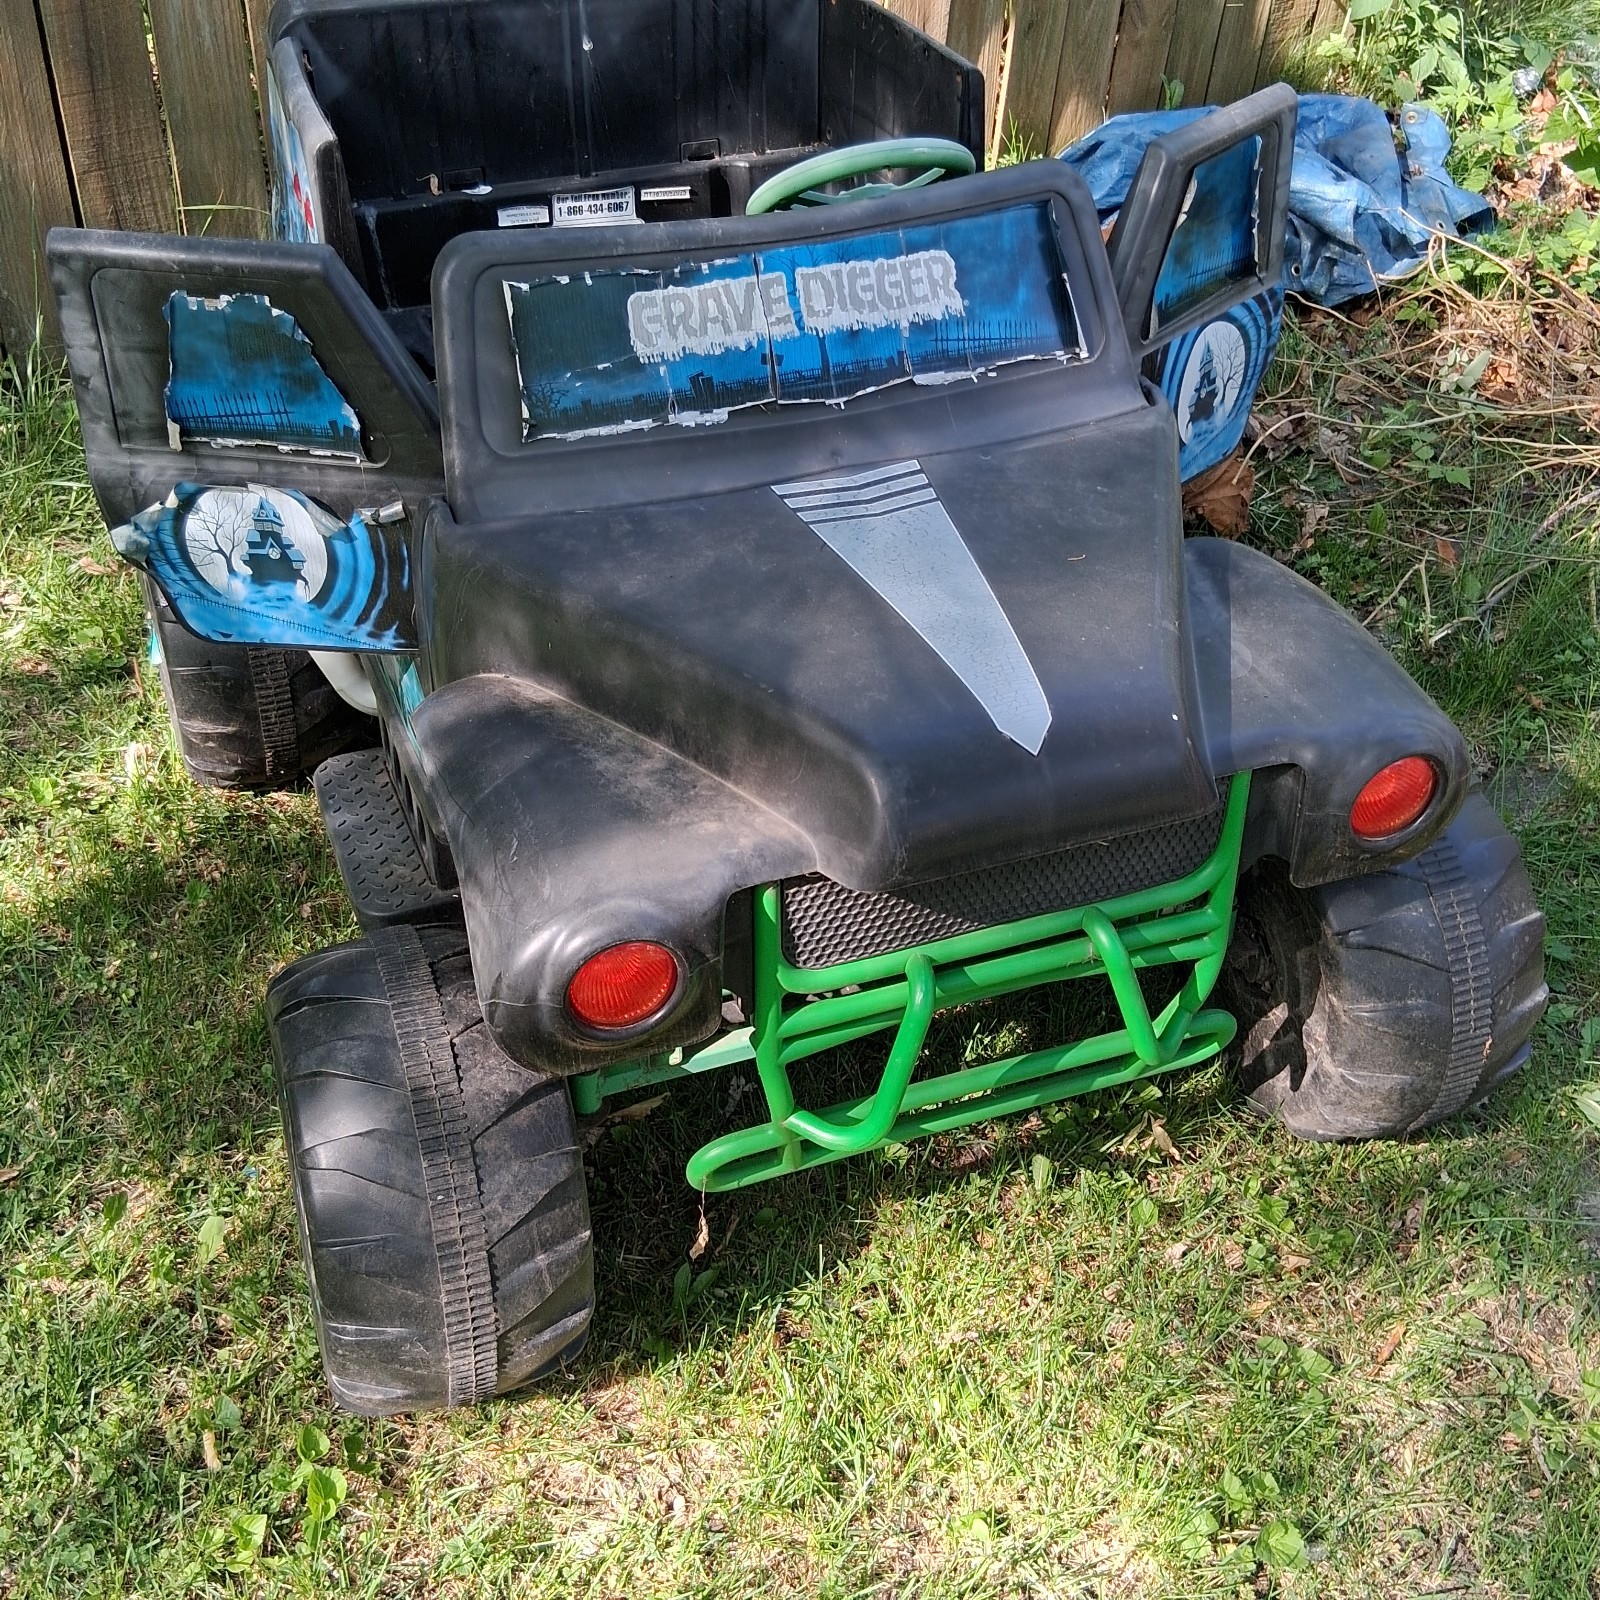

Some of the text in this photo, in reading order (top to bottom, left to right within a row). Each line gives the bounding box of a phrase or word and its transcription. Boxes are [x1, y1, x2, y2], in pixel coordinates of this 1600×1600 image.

[556, 196, 570, 204] Our
[570, 194, 583, 203] Toll
[583, 193, 600, 203] Free
[629, 251, 963, 358] GRAVE DIGGER
